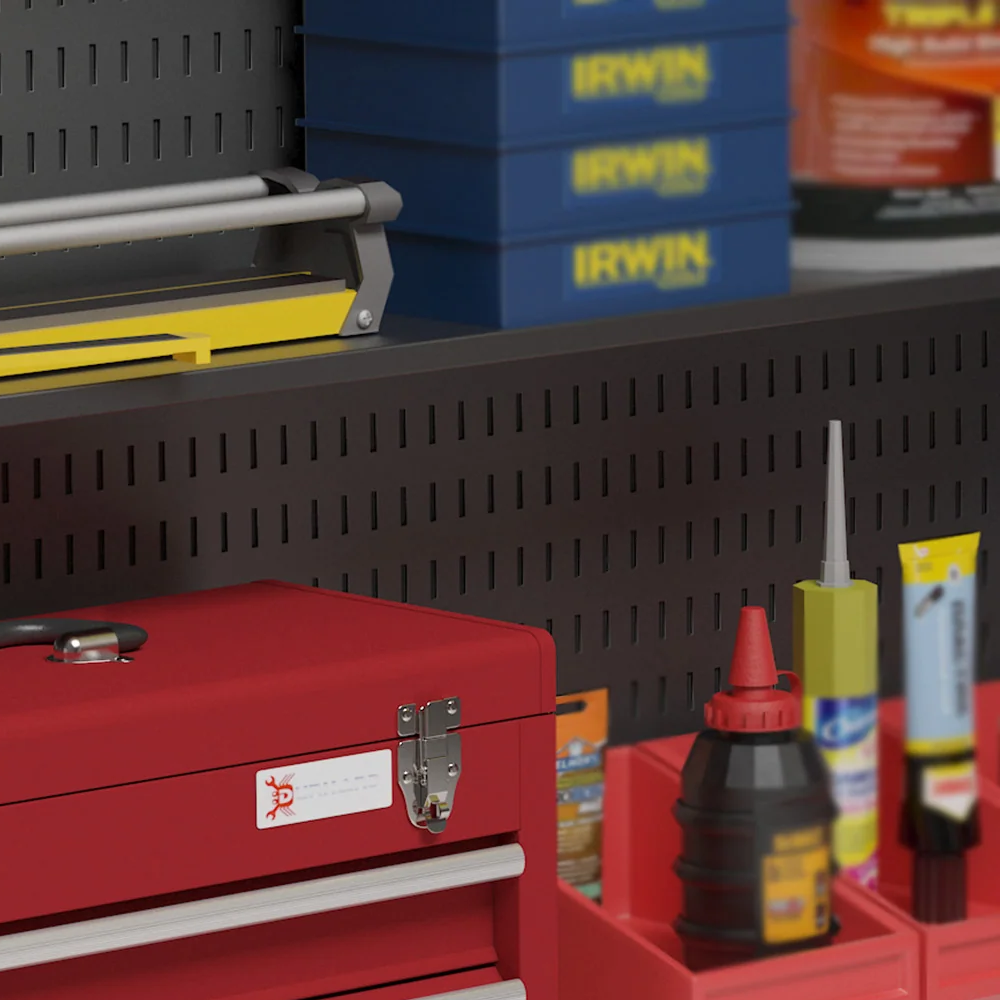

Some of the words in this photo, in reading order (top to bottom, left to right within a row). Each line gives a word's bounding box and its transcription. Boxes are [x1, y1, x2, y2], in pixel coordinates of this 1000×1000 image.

[573, 43, 707, 98] IRWIN
[573, 136, 707, 194] IRWIN
[574, 229, 707, 289] IRWIN
